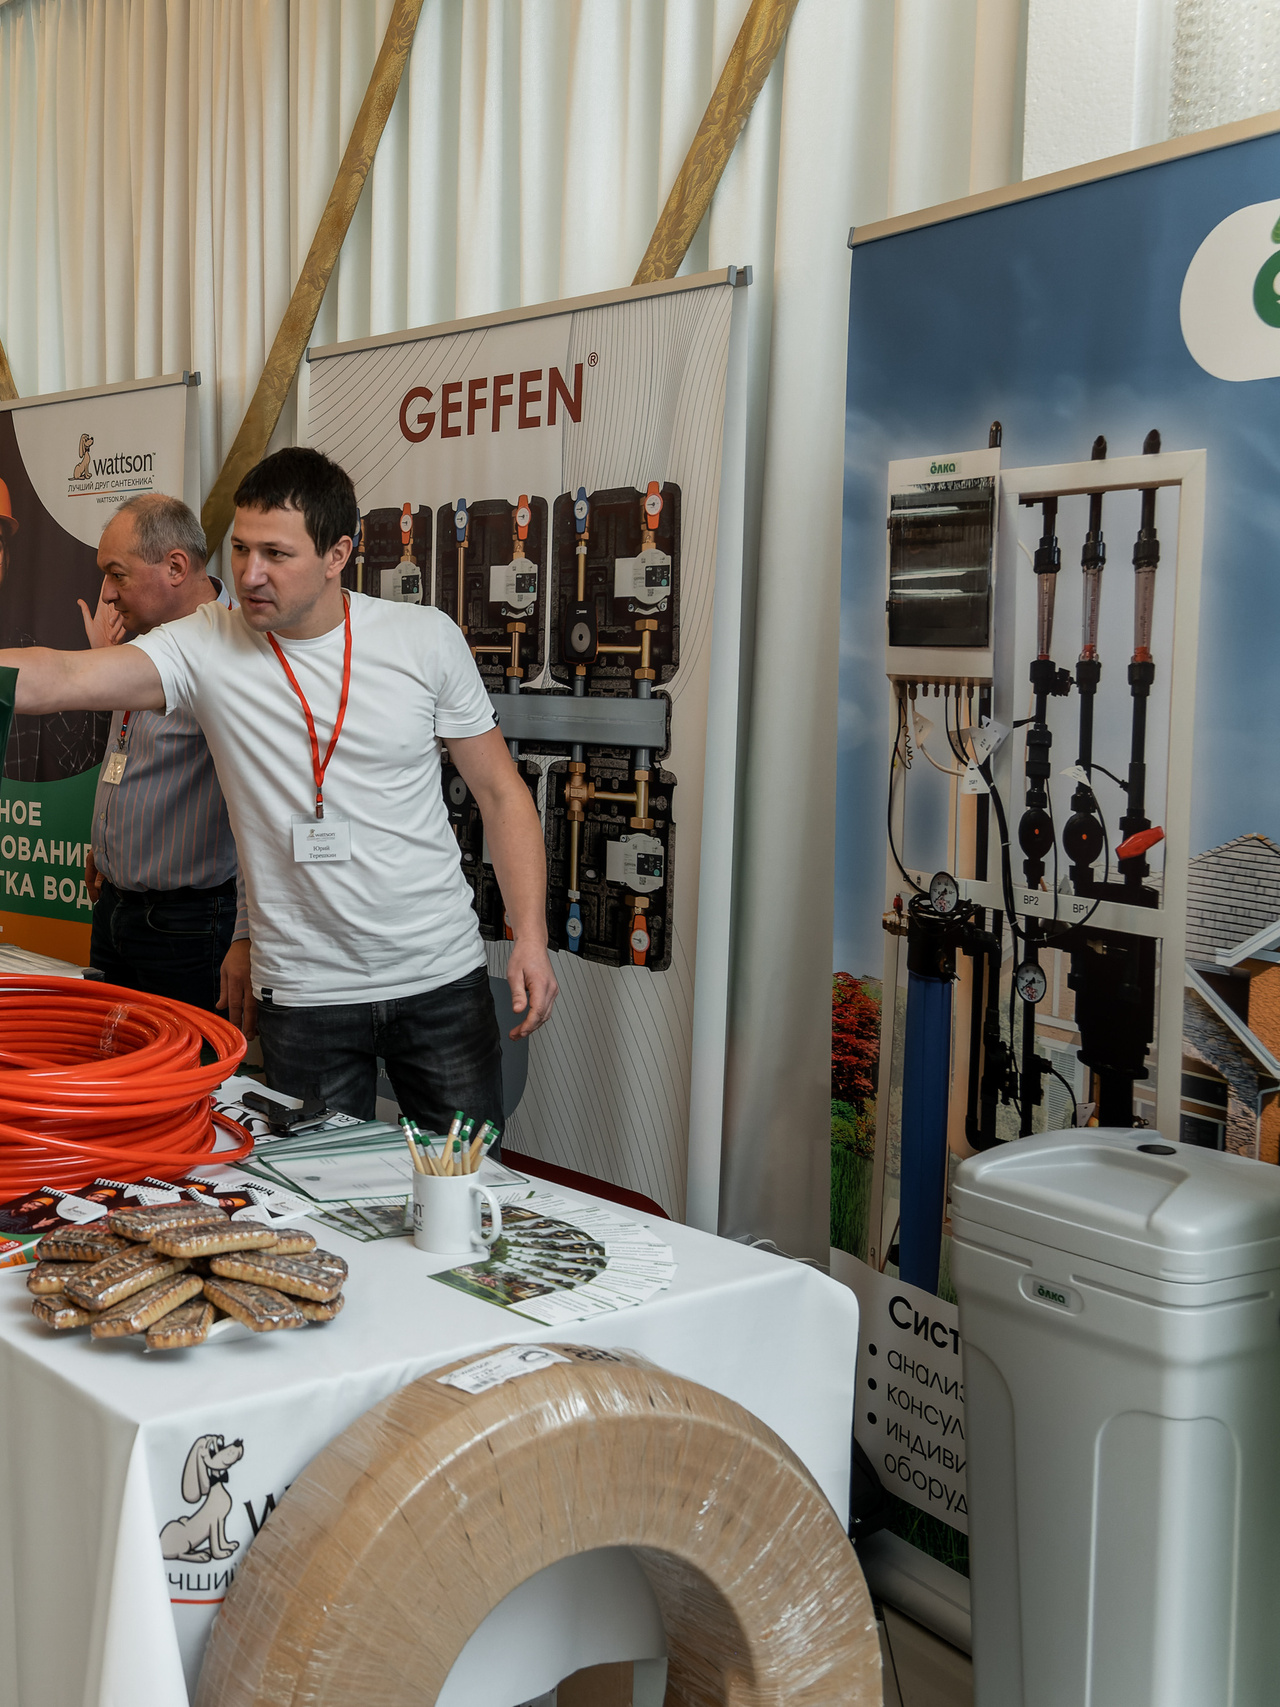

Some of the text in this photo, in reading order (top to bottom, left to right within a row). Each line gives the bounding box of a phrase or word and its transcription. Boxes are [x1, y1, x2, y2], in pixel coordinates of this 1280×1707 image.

[67, 476, 153, 493] ЛУЧШИЙ ДРУГ САНТЕХНИКА
[313, 845, 330, 853] Юрий
